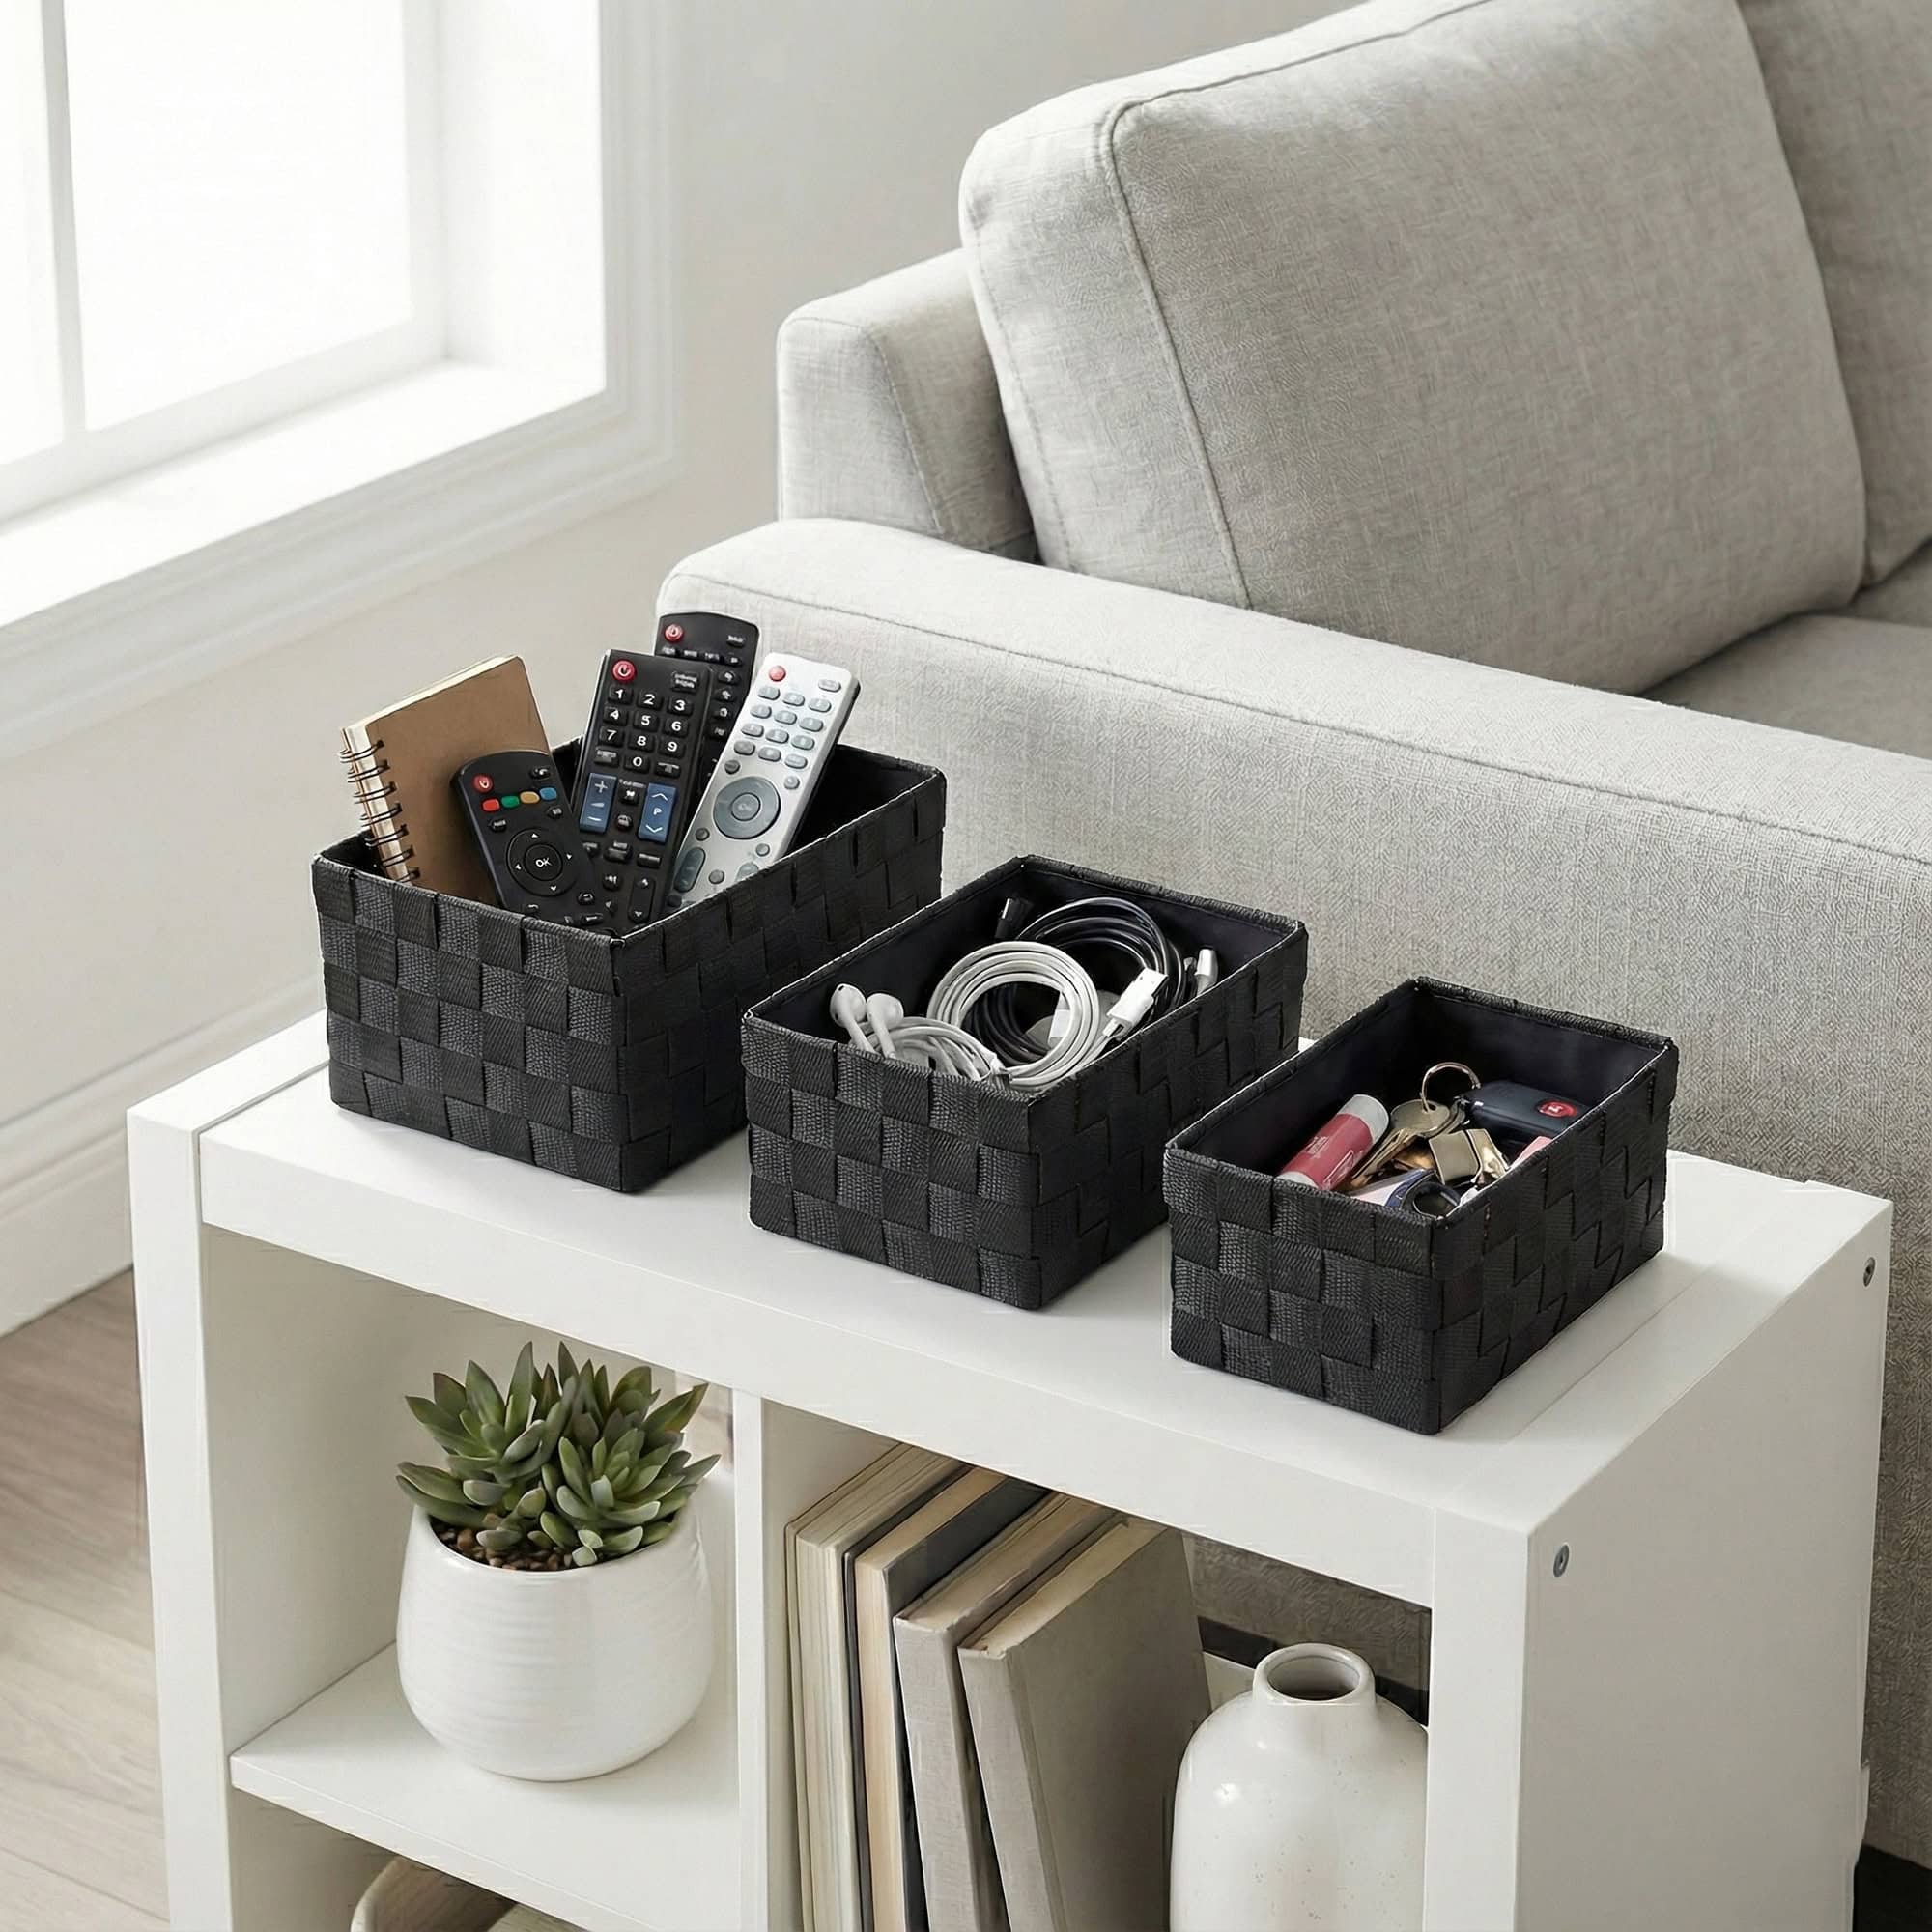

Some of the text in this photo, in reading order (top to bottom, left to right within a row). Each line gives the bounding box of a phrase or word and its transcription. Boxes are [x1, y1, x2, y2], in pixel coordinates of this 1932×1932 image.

[615, 689, 686, 711] 1 2 3
[610, 709, 681, 731] 4 5 6
[607, 729, 678, 752] 7 8 9
[633, 756, 642, 767] 0
[653, 807, 663, 815] P
[535, 857, 553, 867] OK
